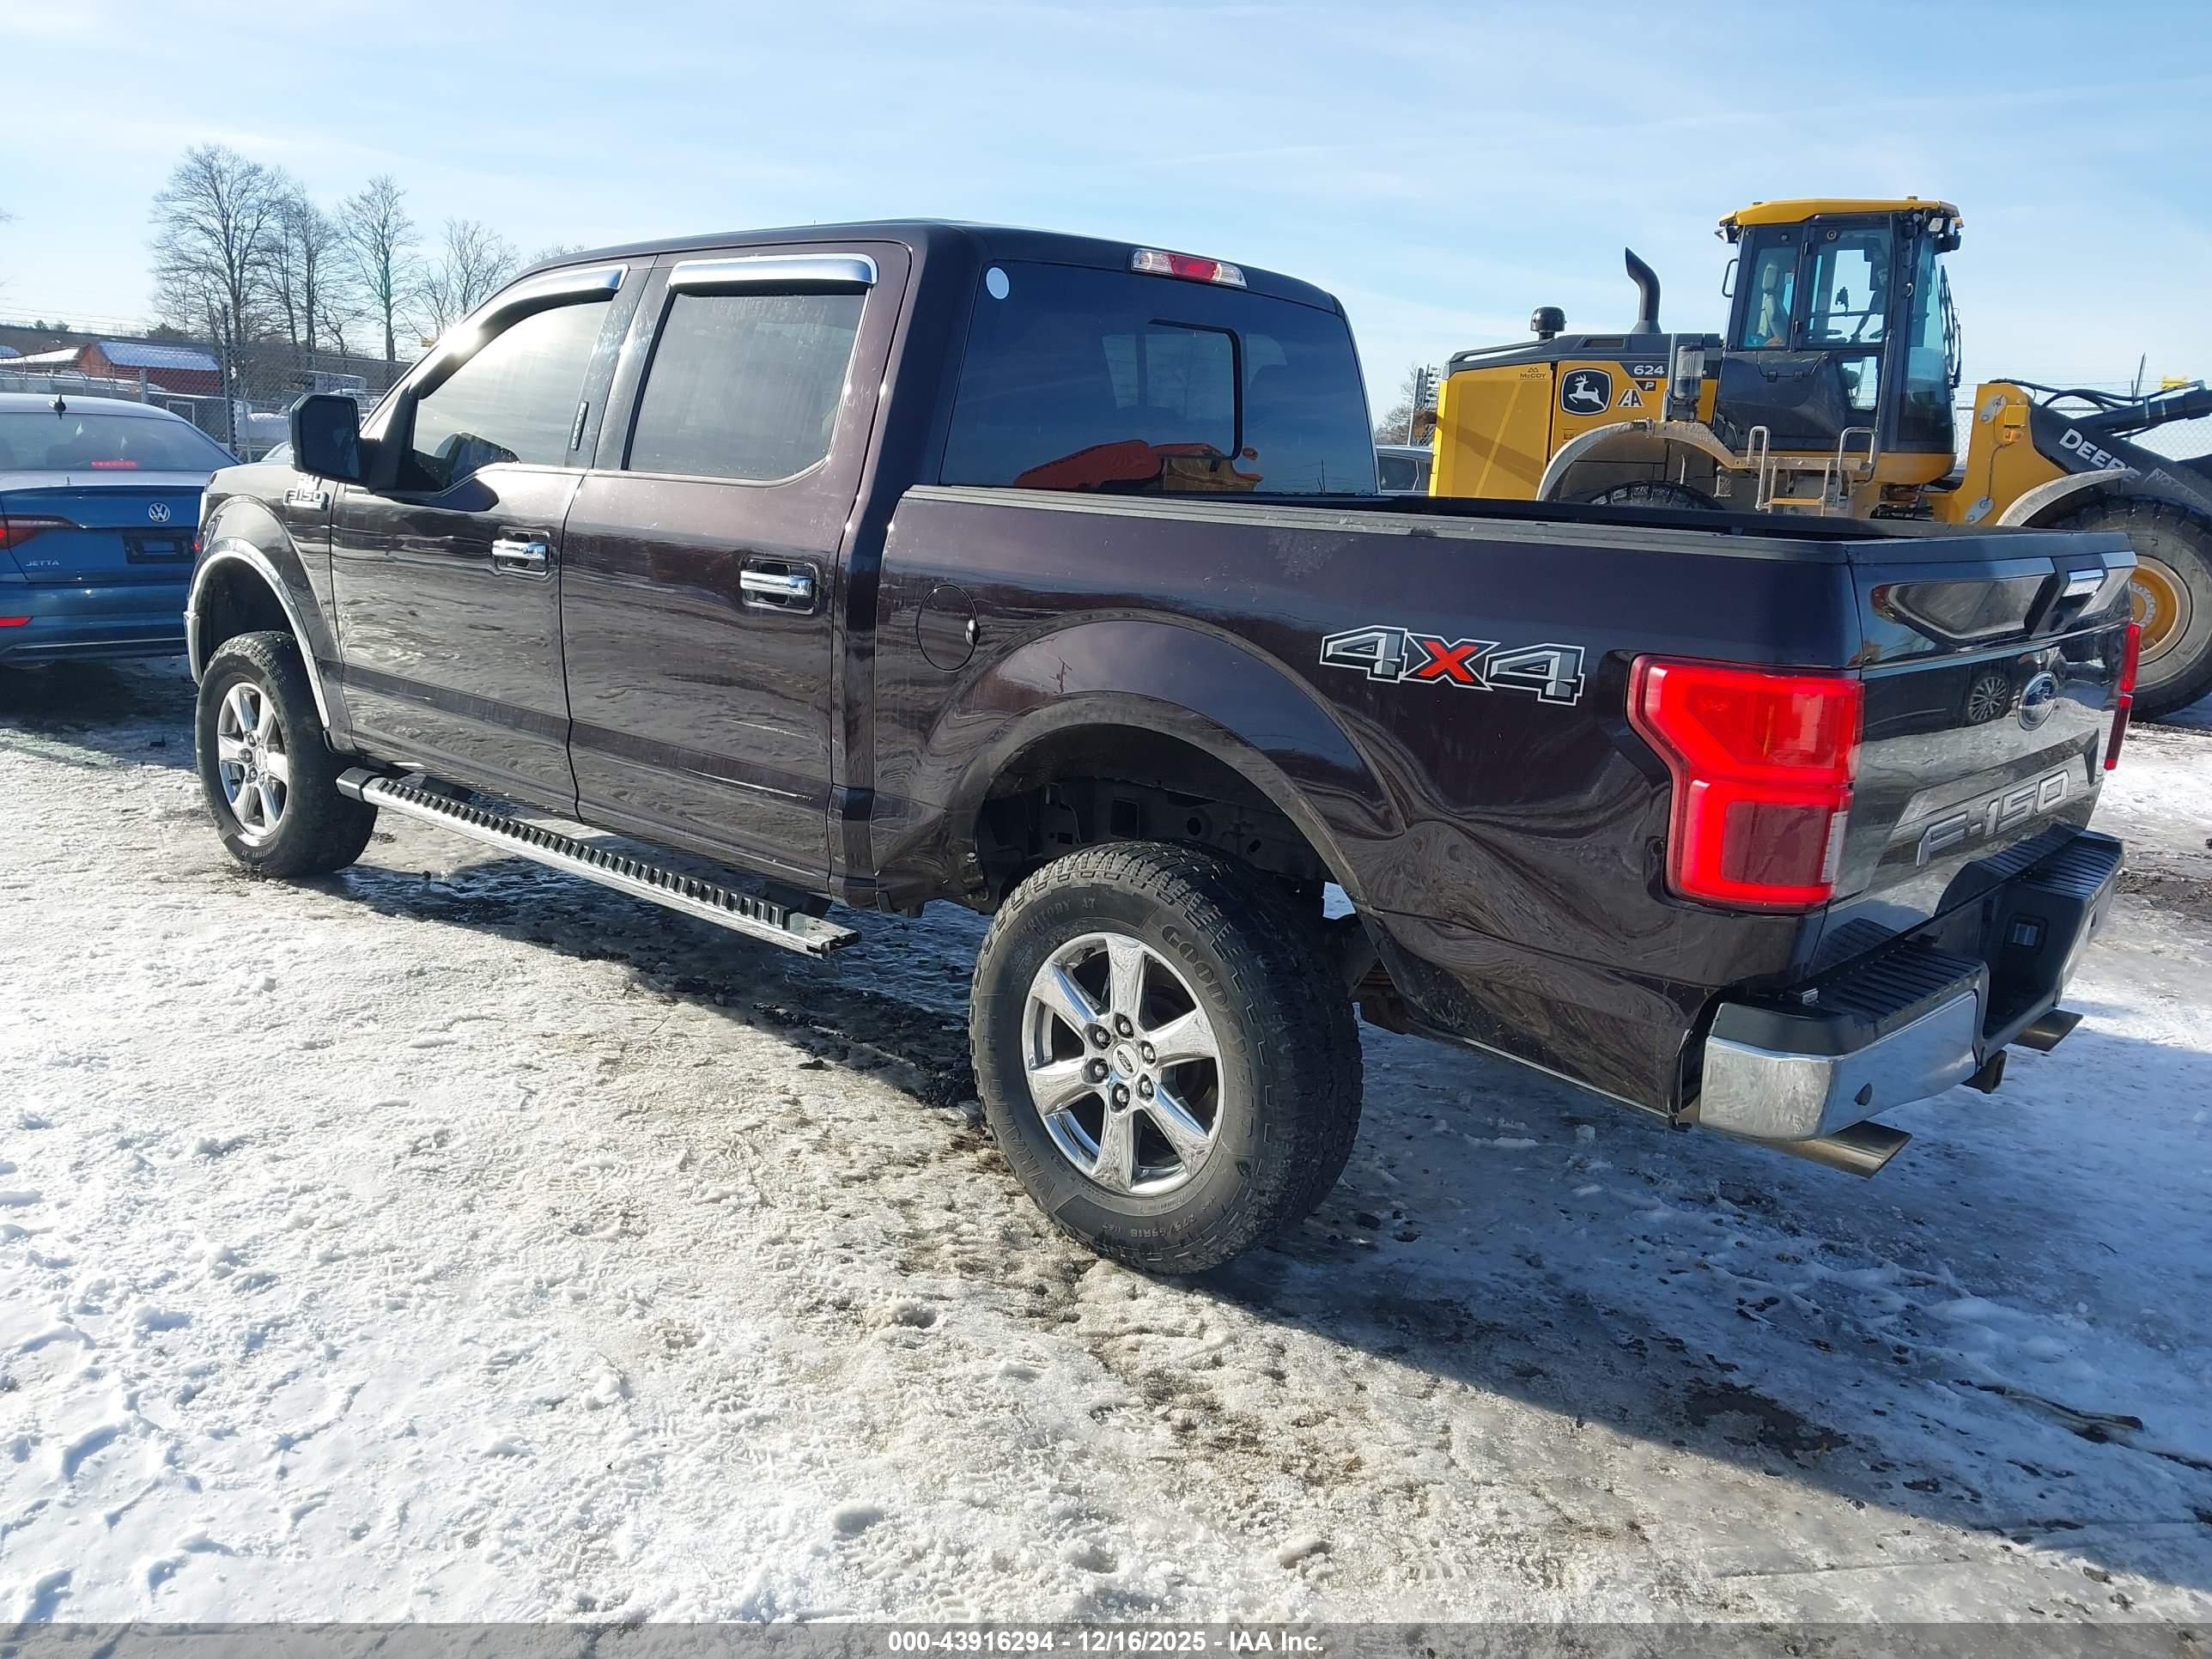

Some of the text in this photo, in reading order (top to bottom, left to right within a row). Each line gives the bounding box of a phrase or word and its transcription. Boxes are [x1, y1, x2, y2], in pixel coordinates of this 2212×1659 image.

[1633, 365, 1665, 375] 624
[1644, 381, 1655, 391] P
[1916, 769, 2069, 868] F-150
